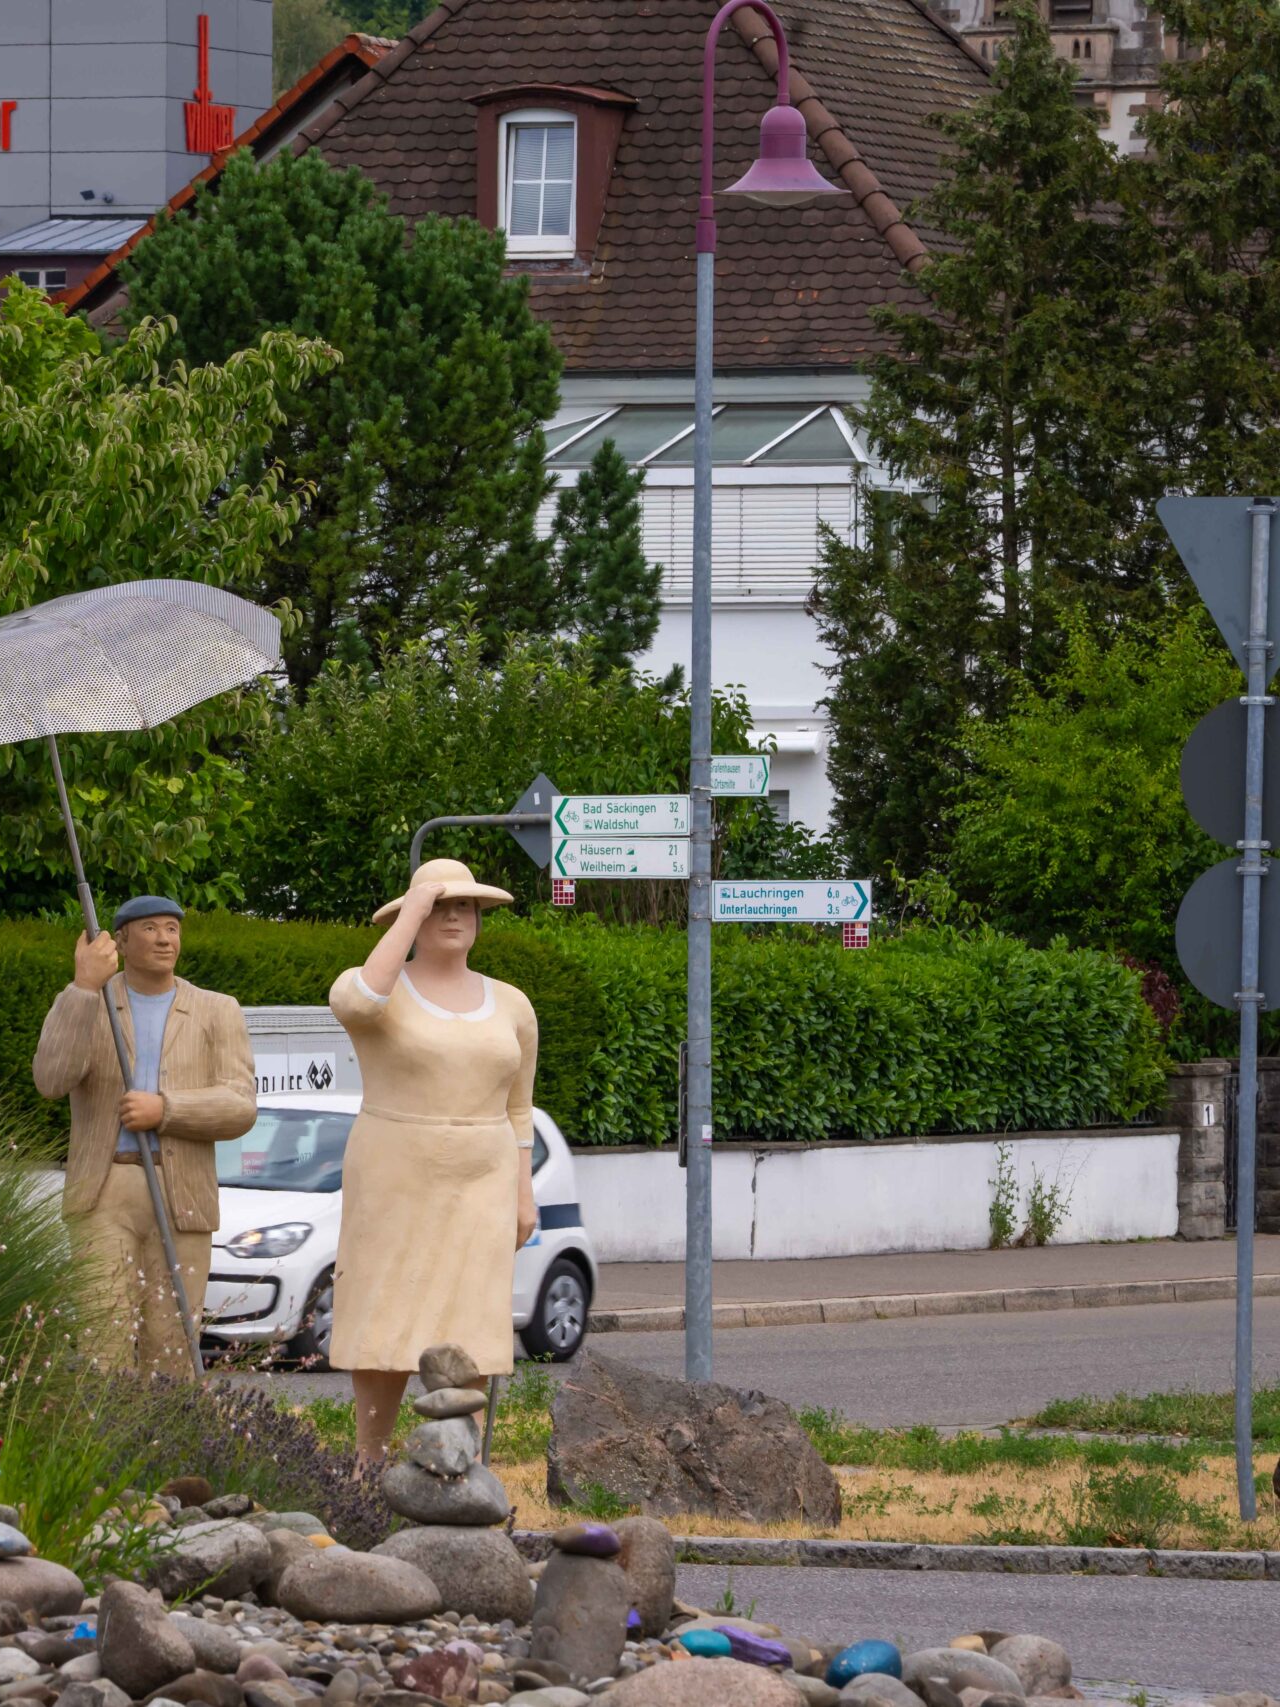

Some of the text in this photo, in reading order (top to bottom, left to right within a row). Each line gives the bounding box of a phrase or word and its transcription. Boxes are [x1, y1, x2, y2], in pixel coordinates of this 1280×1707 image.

[582, 802, 679, 816] Bad Säckingen 32
[593, 818, 639, 830] Waldshut
[580, 844, 678, 856] Häusern 21
[580, 861, 626, 873] Weilheim
[732, 887, 805, 901] Lauchringen
[720, 903, 798, 917] Unterlauchringen
[1205, 1105, 1210, 1125] 1
